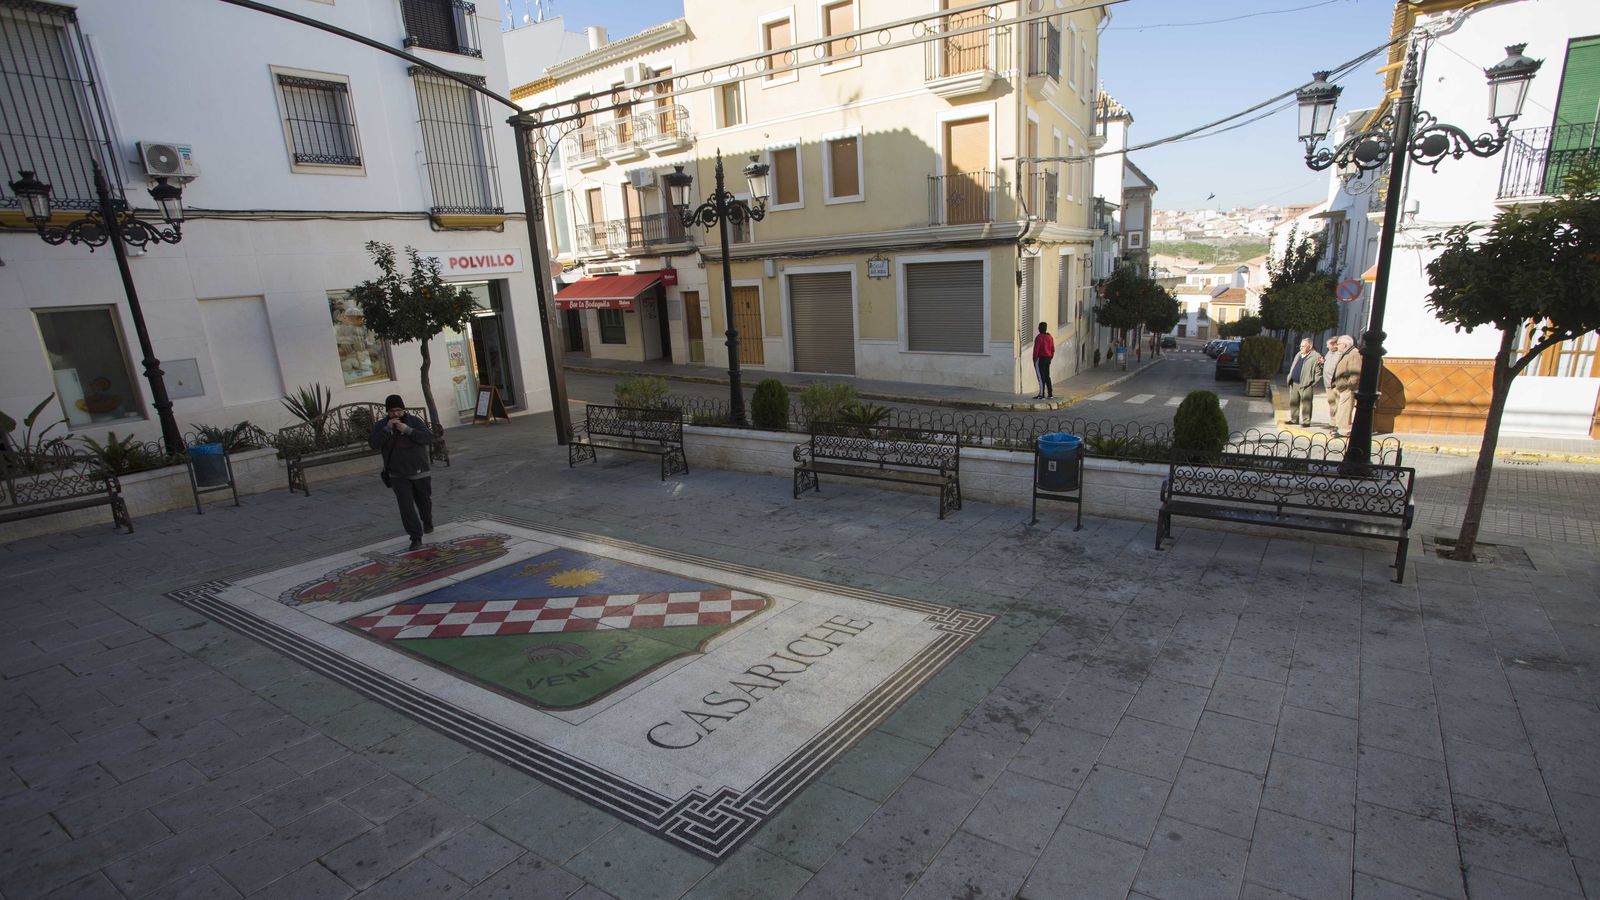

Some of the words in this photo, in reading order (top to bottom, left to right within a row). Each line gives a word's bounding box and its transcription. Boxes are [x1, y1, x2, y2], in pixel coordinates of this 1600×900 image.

[449, 254, 514, 270] POLVILLO
[569, 300, 578, 309] Bar
[579, 300, 585, 308] La
[646, 614, 873, 750] CASARICHE
